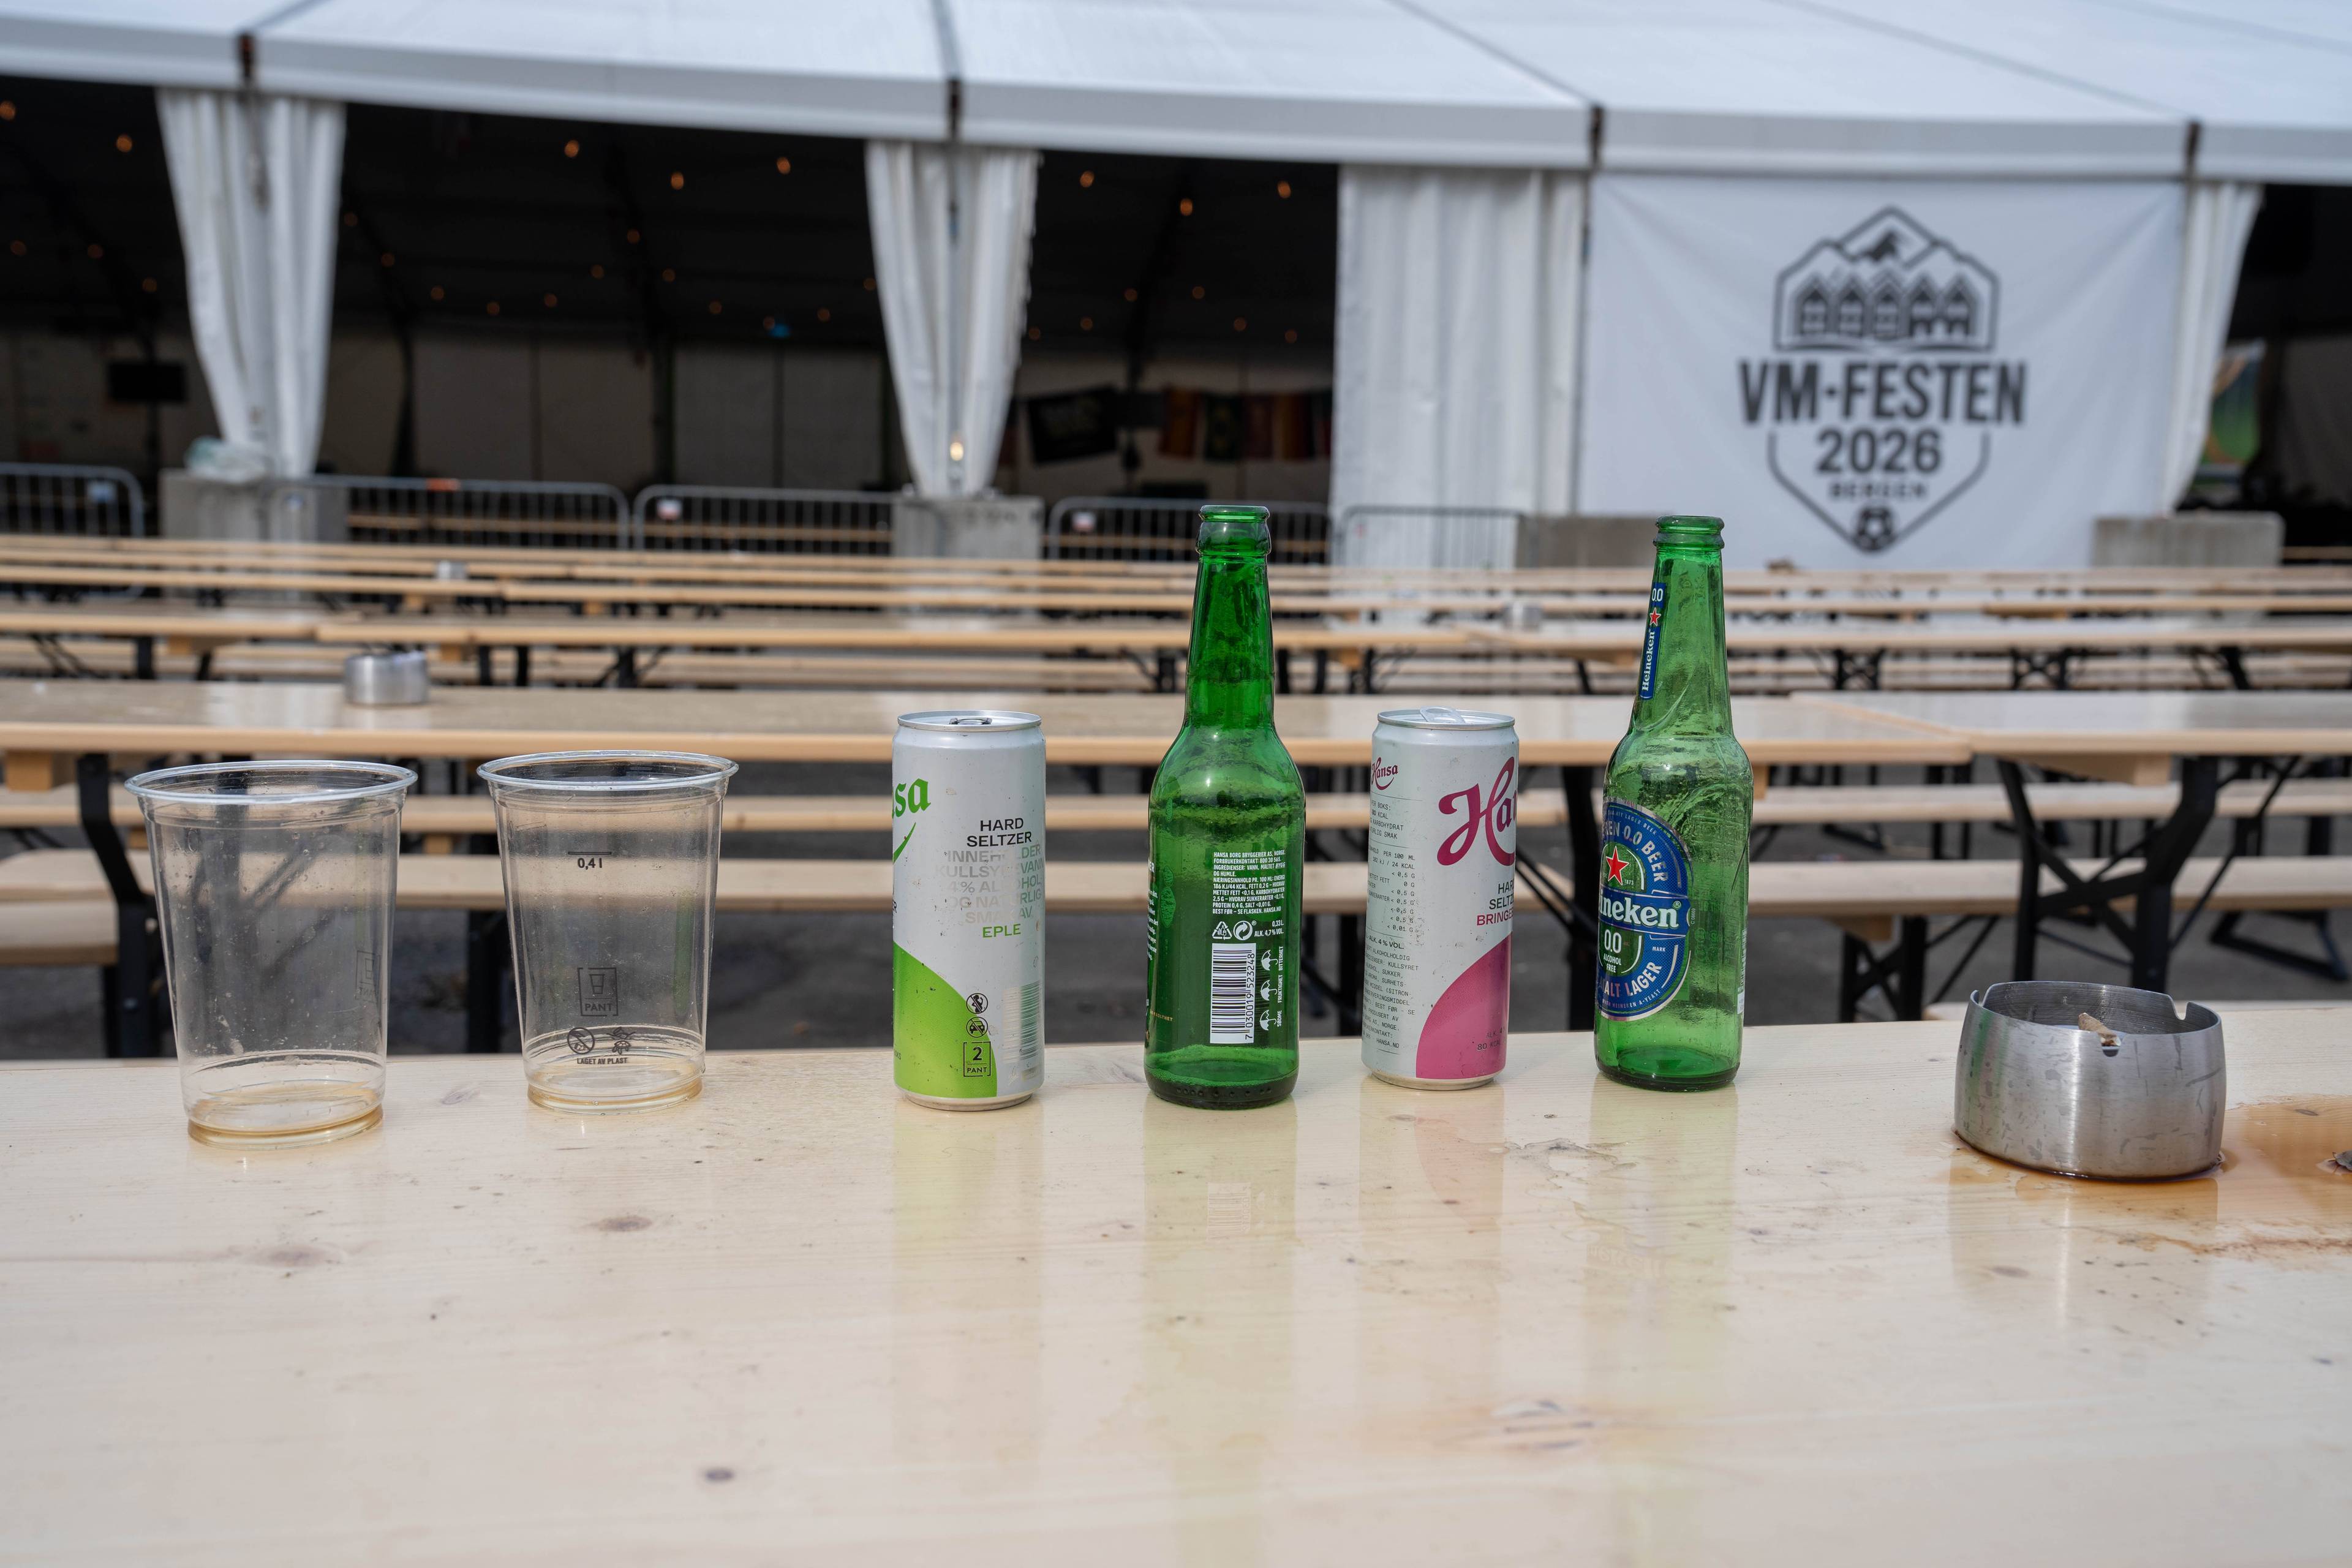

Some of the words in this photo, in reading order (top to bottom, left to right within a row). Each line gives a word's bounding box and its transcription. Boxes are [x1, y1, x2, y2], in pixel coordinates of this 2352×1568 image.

[1816, 429, 1942, 475] 2026
[1651, 588, 1664, 602] 0.0
[1642, 631, 1656, 692] Heineken
[1371, 756, 1399, 790] Hansa
[1378, 802, 1391, 811] BOKS:
[1378, 811, 1389, 820] KCAL
[980, 818, 1024, 832] HARD
[1373, 819, 1404, 831] KARBOHYDRAT
[1625, 813, 1641, 824] LAGER
[1643, 823, 1657, 835] BEER
[967, 831, 1032, 847] SELTZER
[1623, 825, 1643, 845] 0.0
[1642, 840, 1669, 882] BEER
[578, 857, 596, 870] 0,4
[982, 923, 1022, 938] EPLE
[1389, 941, 1404, 949] VOL.
[1604, 929, 1622, 954] 0.0
[1373, 948, 1410, 961] ALKOHOLHOLDIG
[1604, 953, 1622, 966] ALCOHOL
[1246, 953, 1255, 989] 523248
[1388, 961, 1419, 971] KULLSYRET
[1606, 963, 1616, 973] FREE
[1382, 969, 1403, 979] SUKKER,
[1624, 962, 1662, 997] LAGER
[1382, 978, 1407, 987] SURHETS-
[1370, 983, 1383, 992] MIDDEL
[1386, 988, 1412, 997] (SITRON-
[1639, 989, 1660, 1005] A-YEAST
[585, 1003, 612, 1012] PANT
[1245, 993, 1254, 1028] 030019
[1368, 1008, 1389, 1020] PRODUSERT
[1376, 1038, 1400, 1049] HANSA.NO
[973, 1046, 983, 1061] 2
